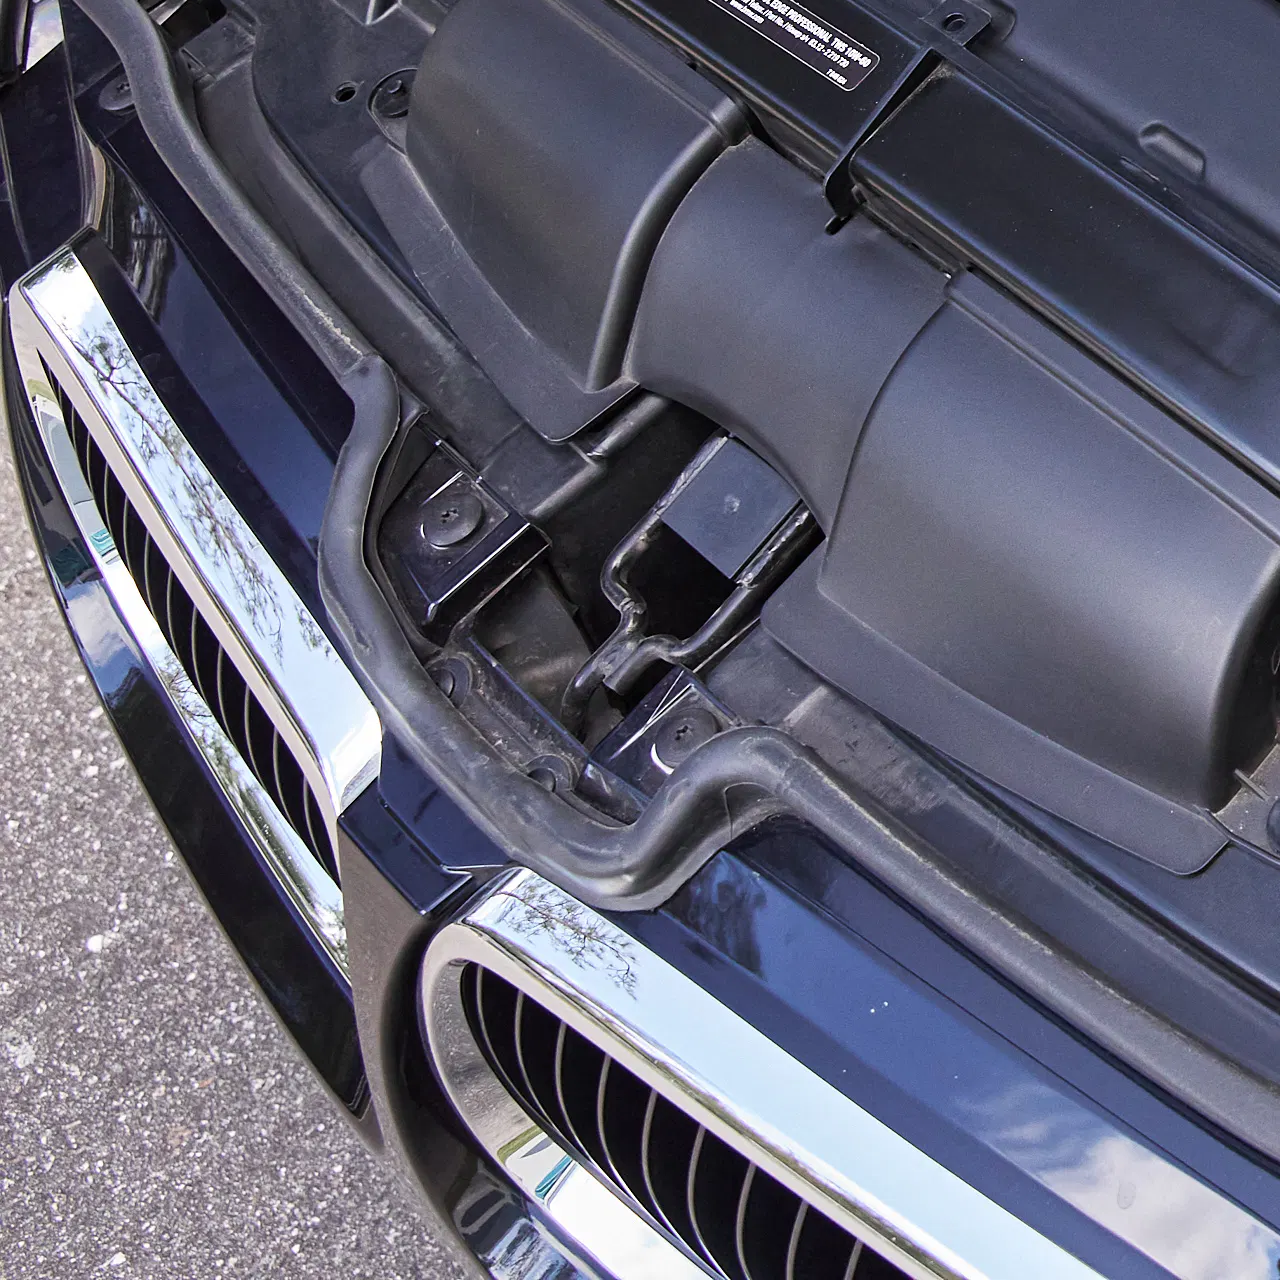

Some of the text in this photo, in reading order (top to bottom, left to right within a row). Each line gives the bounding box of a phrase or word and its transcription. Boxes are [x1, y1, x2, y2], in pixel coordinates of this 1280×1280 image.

[769, 0, 790, 15] EDGE
[787, 9, 832, 43] PROFESSIONAL
[831, 37, 848, 52] TWS
